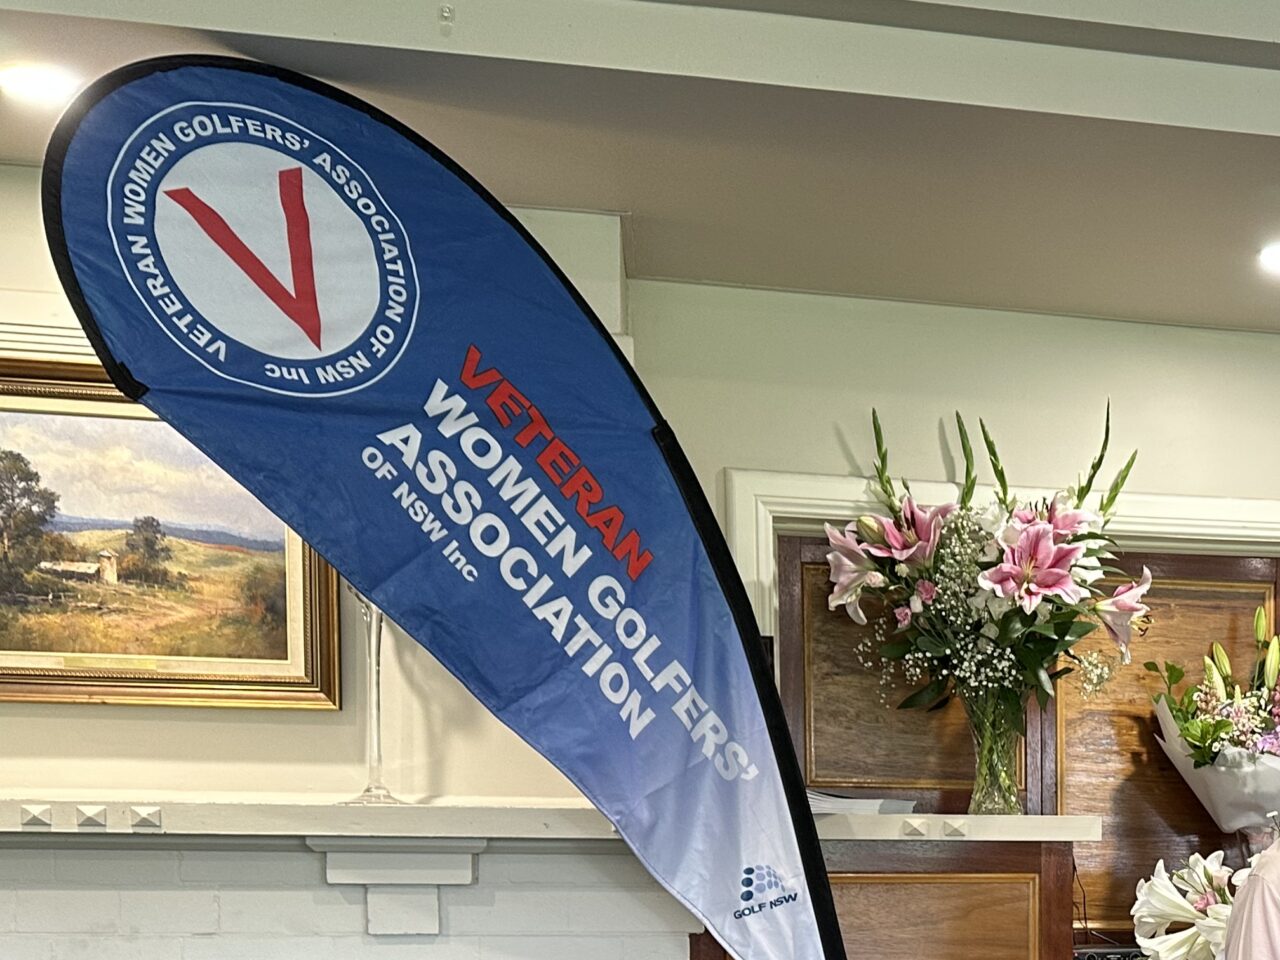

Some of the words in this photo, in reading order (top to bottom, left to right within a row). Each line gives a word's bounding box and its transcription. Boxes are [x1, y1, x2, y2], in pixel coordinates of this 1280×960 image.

[123, 132, 177, 226] WOMEN
[312, 152, 408, 324] ASSOCIATION
[127, 235, 227, 363] VETERAN
[162, 166, 322, 352] V
[264, 363, 311, 385] Inc
[316, 351, 372, 385] NSW
[372, 327, 395, 359] OF
[361, 446, 398, 484] OF
[392, 486, 449, 544] NSW
[442, 539, 479, 583] Inc
[422, 378, 593, 579] WOMEN
[458, 343, 655, 581] VETERAN
[376, 422, 657, 741] ASSOCIATION
[733, 901, 767, 920] GOLF
[769, 892, 798, 910] NSW
